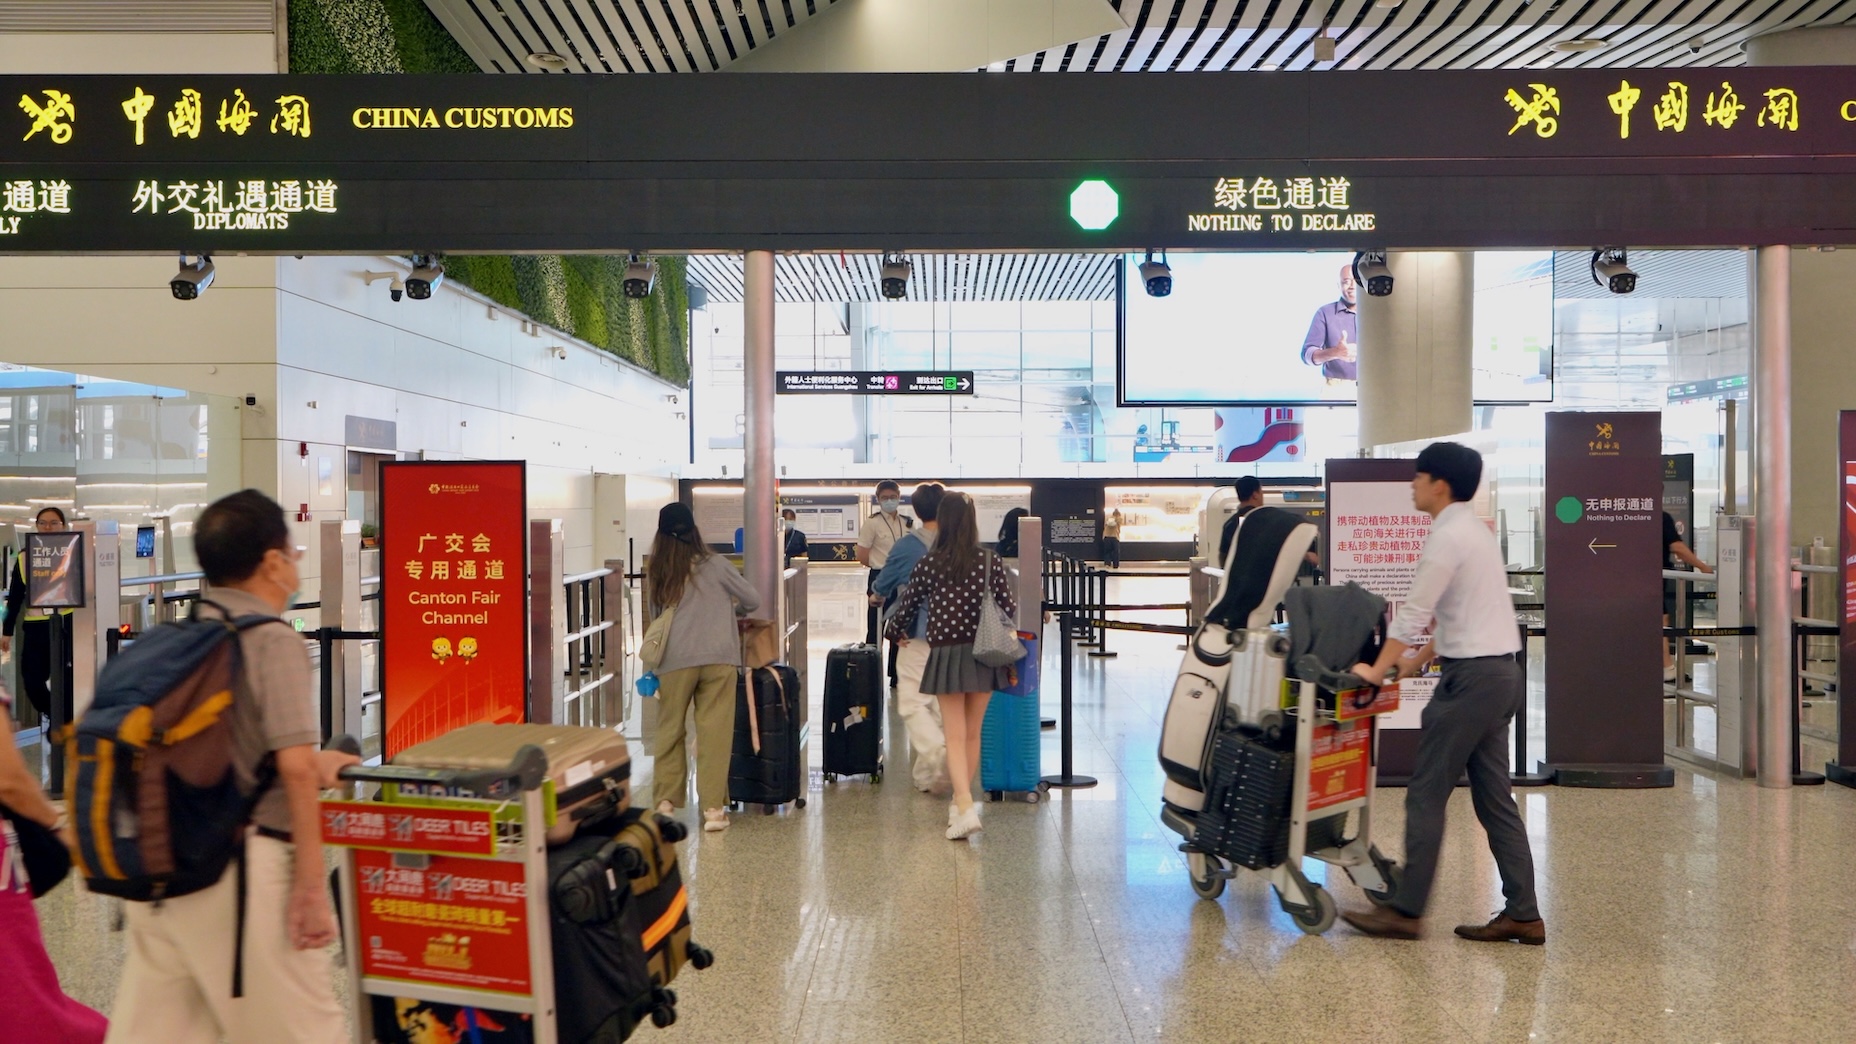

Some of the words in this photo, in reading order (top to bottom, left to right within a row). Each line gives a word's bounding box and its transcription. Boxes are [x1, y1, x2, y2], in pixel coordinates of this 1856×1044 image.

[352, 107, 441, 129] CHINA
[444, 107, 574, 129] CUSTOMS
[2, 179, 72, 213] 通道
[131, 178, 339, 214] 外交礼遇通道
[1213, 175, 1352, 211] 绿色通道
[193, 212, 289, 231] DIPLOMATS
[1187, 213, 1263, 232] NOTHING
[1270, 213, 1294, 232] TO
[1301, 213, 1376, 232] DECLARE
[1586, 498, 1654, 511] 无申报通道
[1337, 515, 1432, 526] 携带动植物及其制品
[1586, 514, 1615, 522] Nothing
[417, 533, 491, 553] 广交会
[1337, 540, 1426, 551] 走私珍贵动植物及
[33, 546, 69, 557] 工作人员
[32, 557, 52, 568] 通道
[404, 559, 505, 580] 专用通道
[32, 569, 50, 577] Staff
[408, 591, 467, 605] Canton
[471, 590, 501, 605] Fair
[422, 610, 488, 625] Channel
[451, 819, 491, 836] TILES
